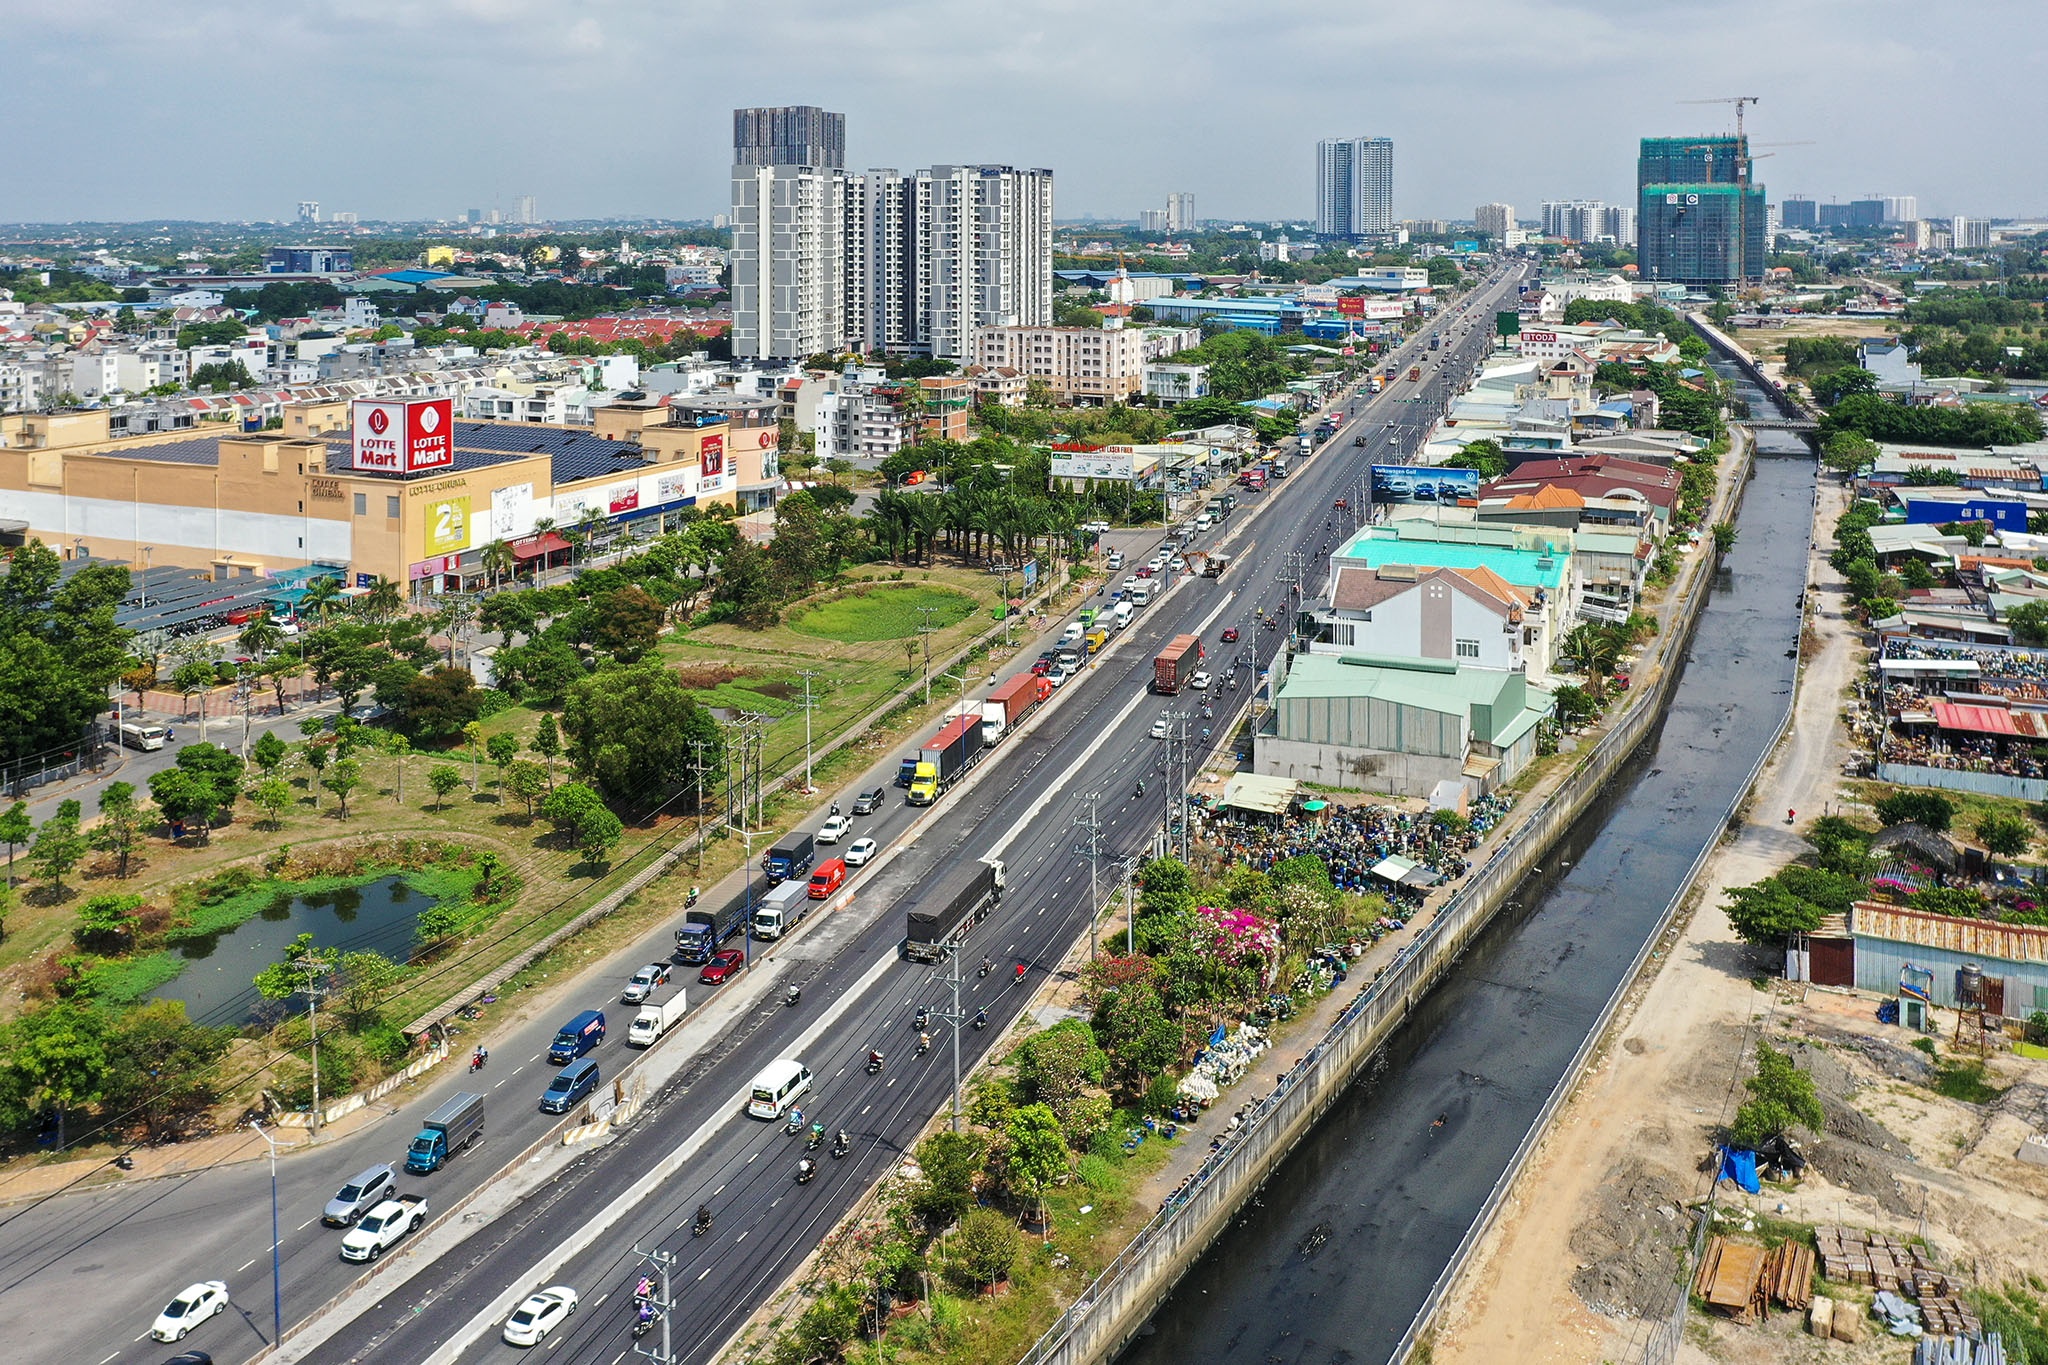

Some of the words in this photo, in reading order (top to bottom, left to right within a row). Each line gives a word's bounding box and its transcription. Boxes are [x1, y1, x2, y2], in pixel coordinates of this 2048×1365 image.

[361, 439, 396, 449] LOTTE
[414, 435, 445, 448] LOTTE
[361, 451, 397, 466] Mart
[414, 447, 446, 465] Mart
[312, 488, 344, 498] CINEMA
[435, 504, 451, 537] 2
[512, 535, 538, 547] LOTTERIA
